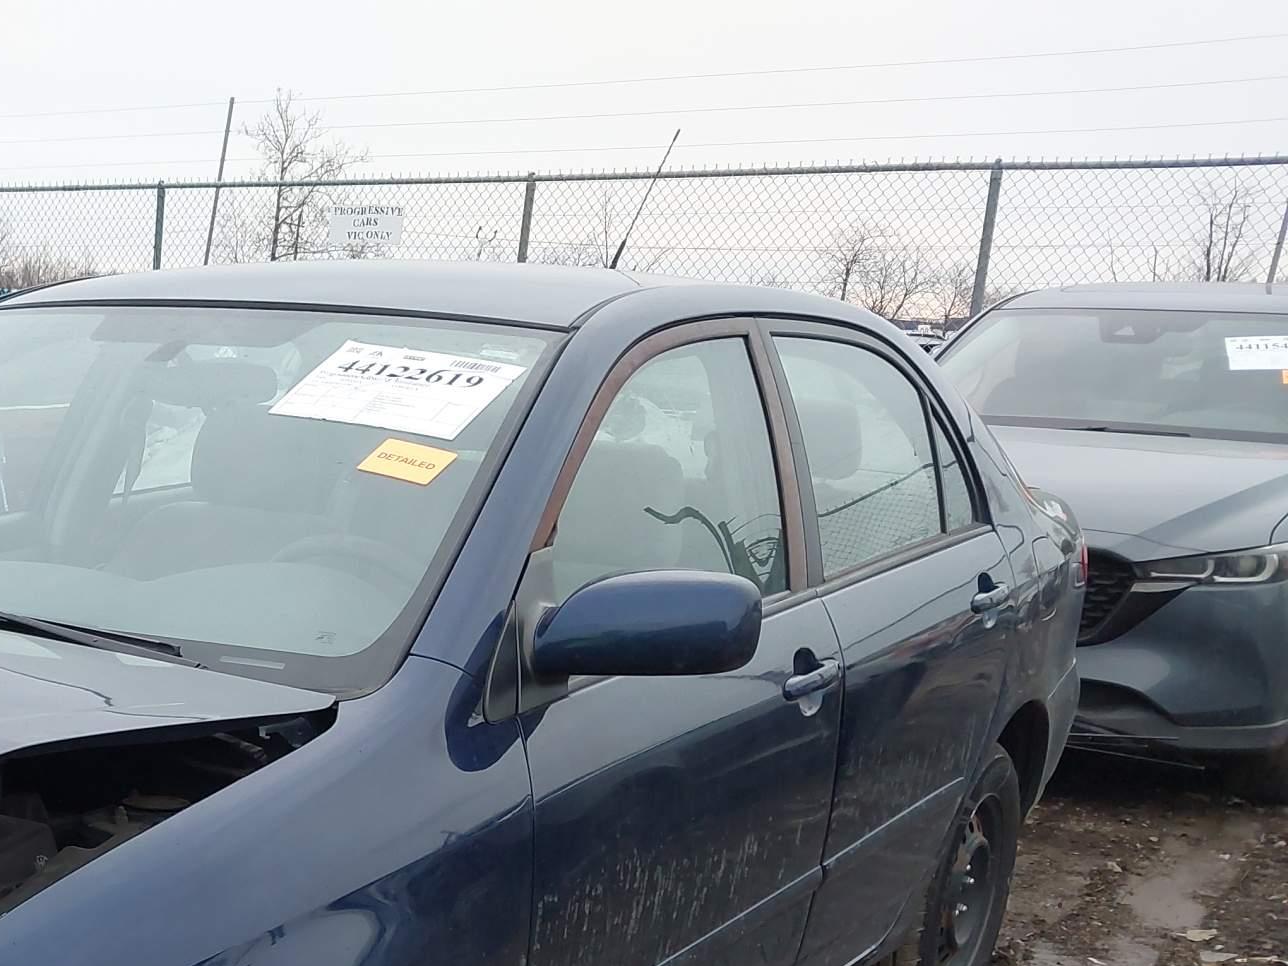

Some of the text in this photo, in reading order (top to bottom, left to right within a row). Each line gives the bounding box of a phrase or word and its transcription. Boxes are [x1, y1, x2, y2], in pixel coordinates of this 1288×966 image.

[333, 205, 404, 217] PROGRESSIVE
[352, 217, 379, 228] CARS
[365, 230, 393, 240] ONLY
[338, 359, 485, 388] 44122619
[376, 451, 437, 471] DETAILED
